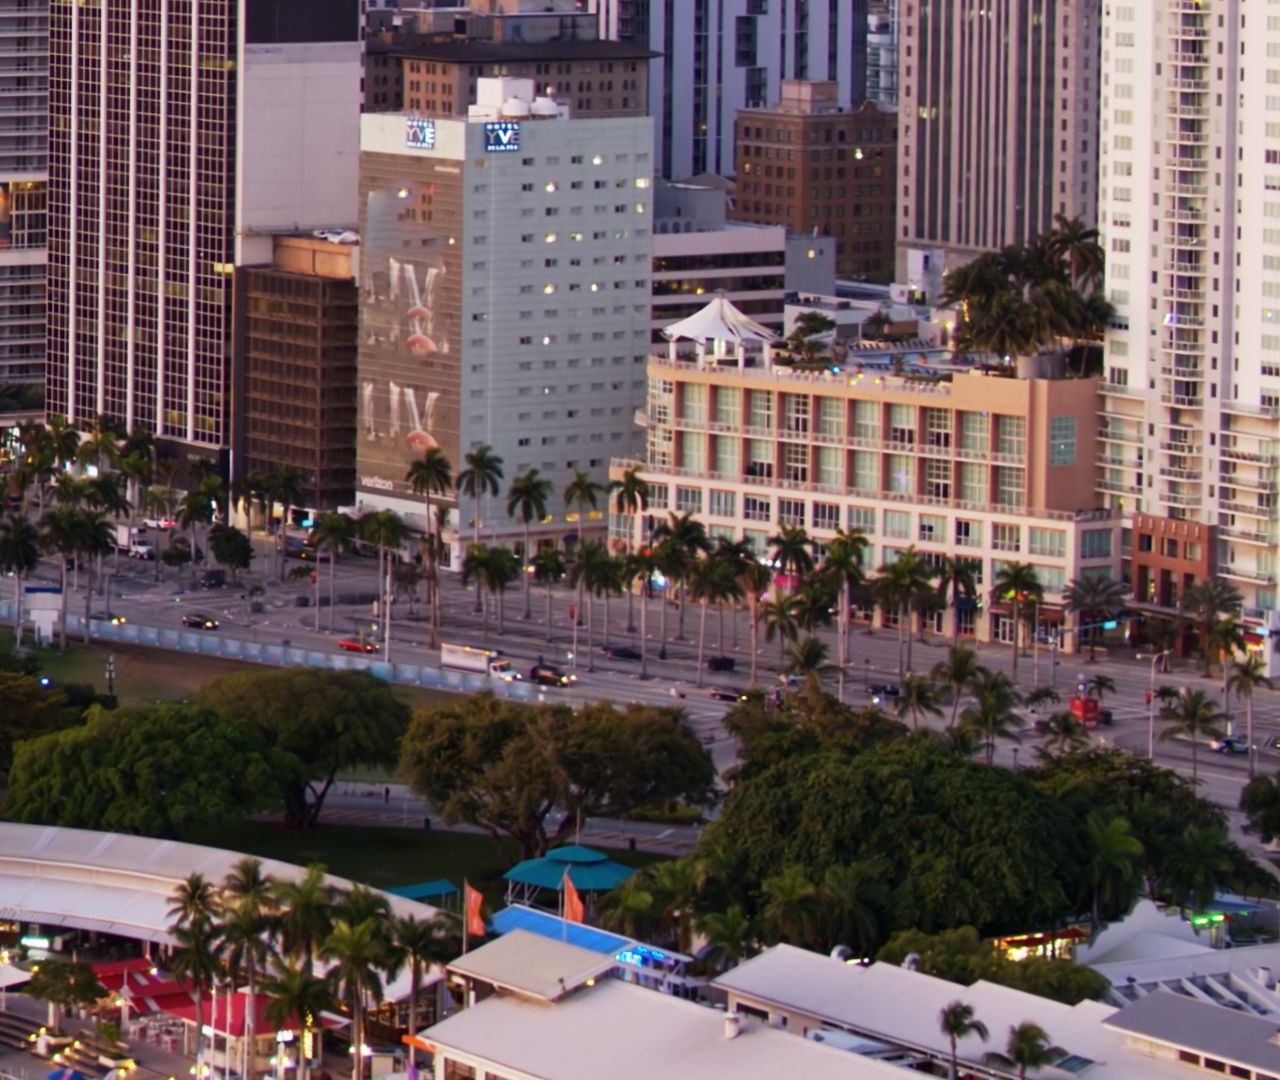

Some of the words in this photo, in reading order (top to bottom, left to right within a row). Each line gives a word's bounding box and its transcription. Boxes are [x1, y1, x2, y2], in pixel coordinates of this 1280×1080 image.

[406, 127, 435, 143] YVE
[485, 130, 520, 144] YVE
[361, 477, 393, 491] verizon
